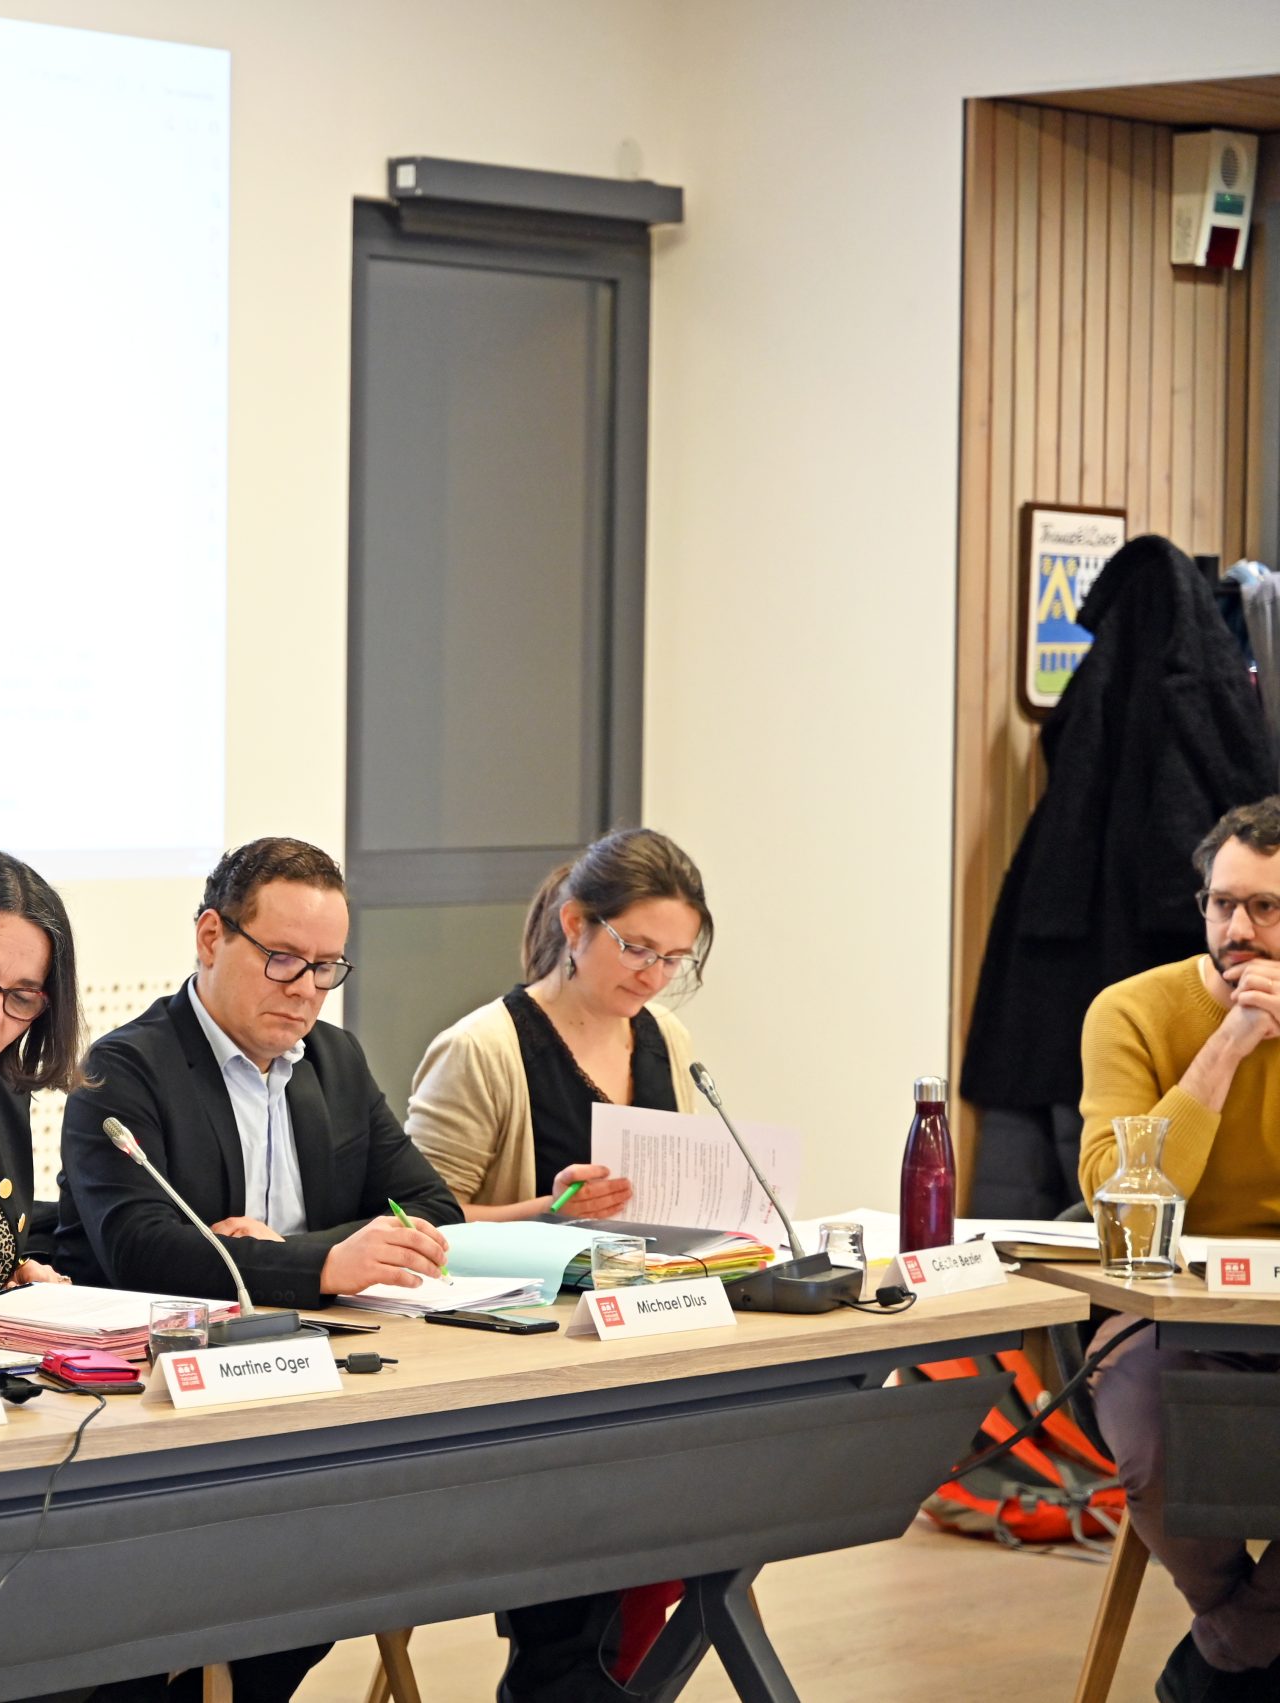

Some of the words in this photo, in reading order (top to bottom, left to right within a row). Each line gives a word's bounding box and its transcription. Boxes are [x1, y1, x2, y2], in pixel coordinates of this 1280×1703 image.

[636, 1296, 682, 1314] Michael
[219, 1359, 272, 1379] Martine
[275, 1355, 311, 1374] Oger
